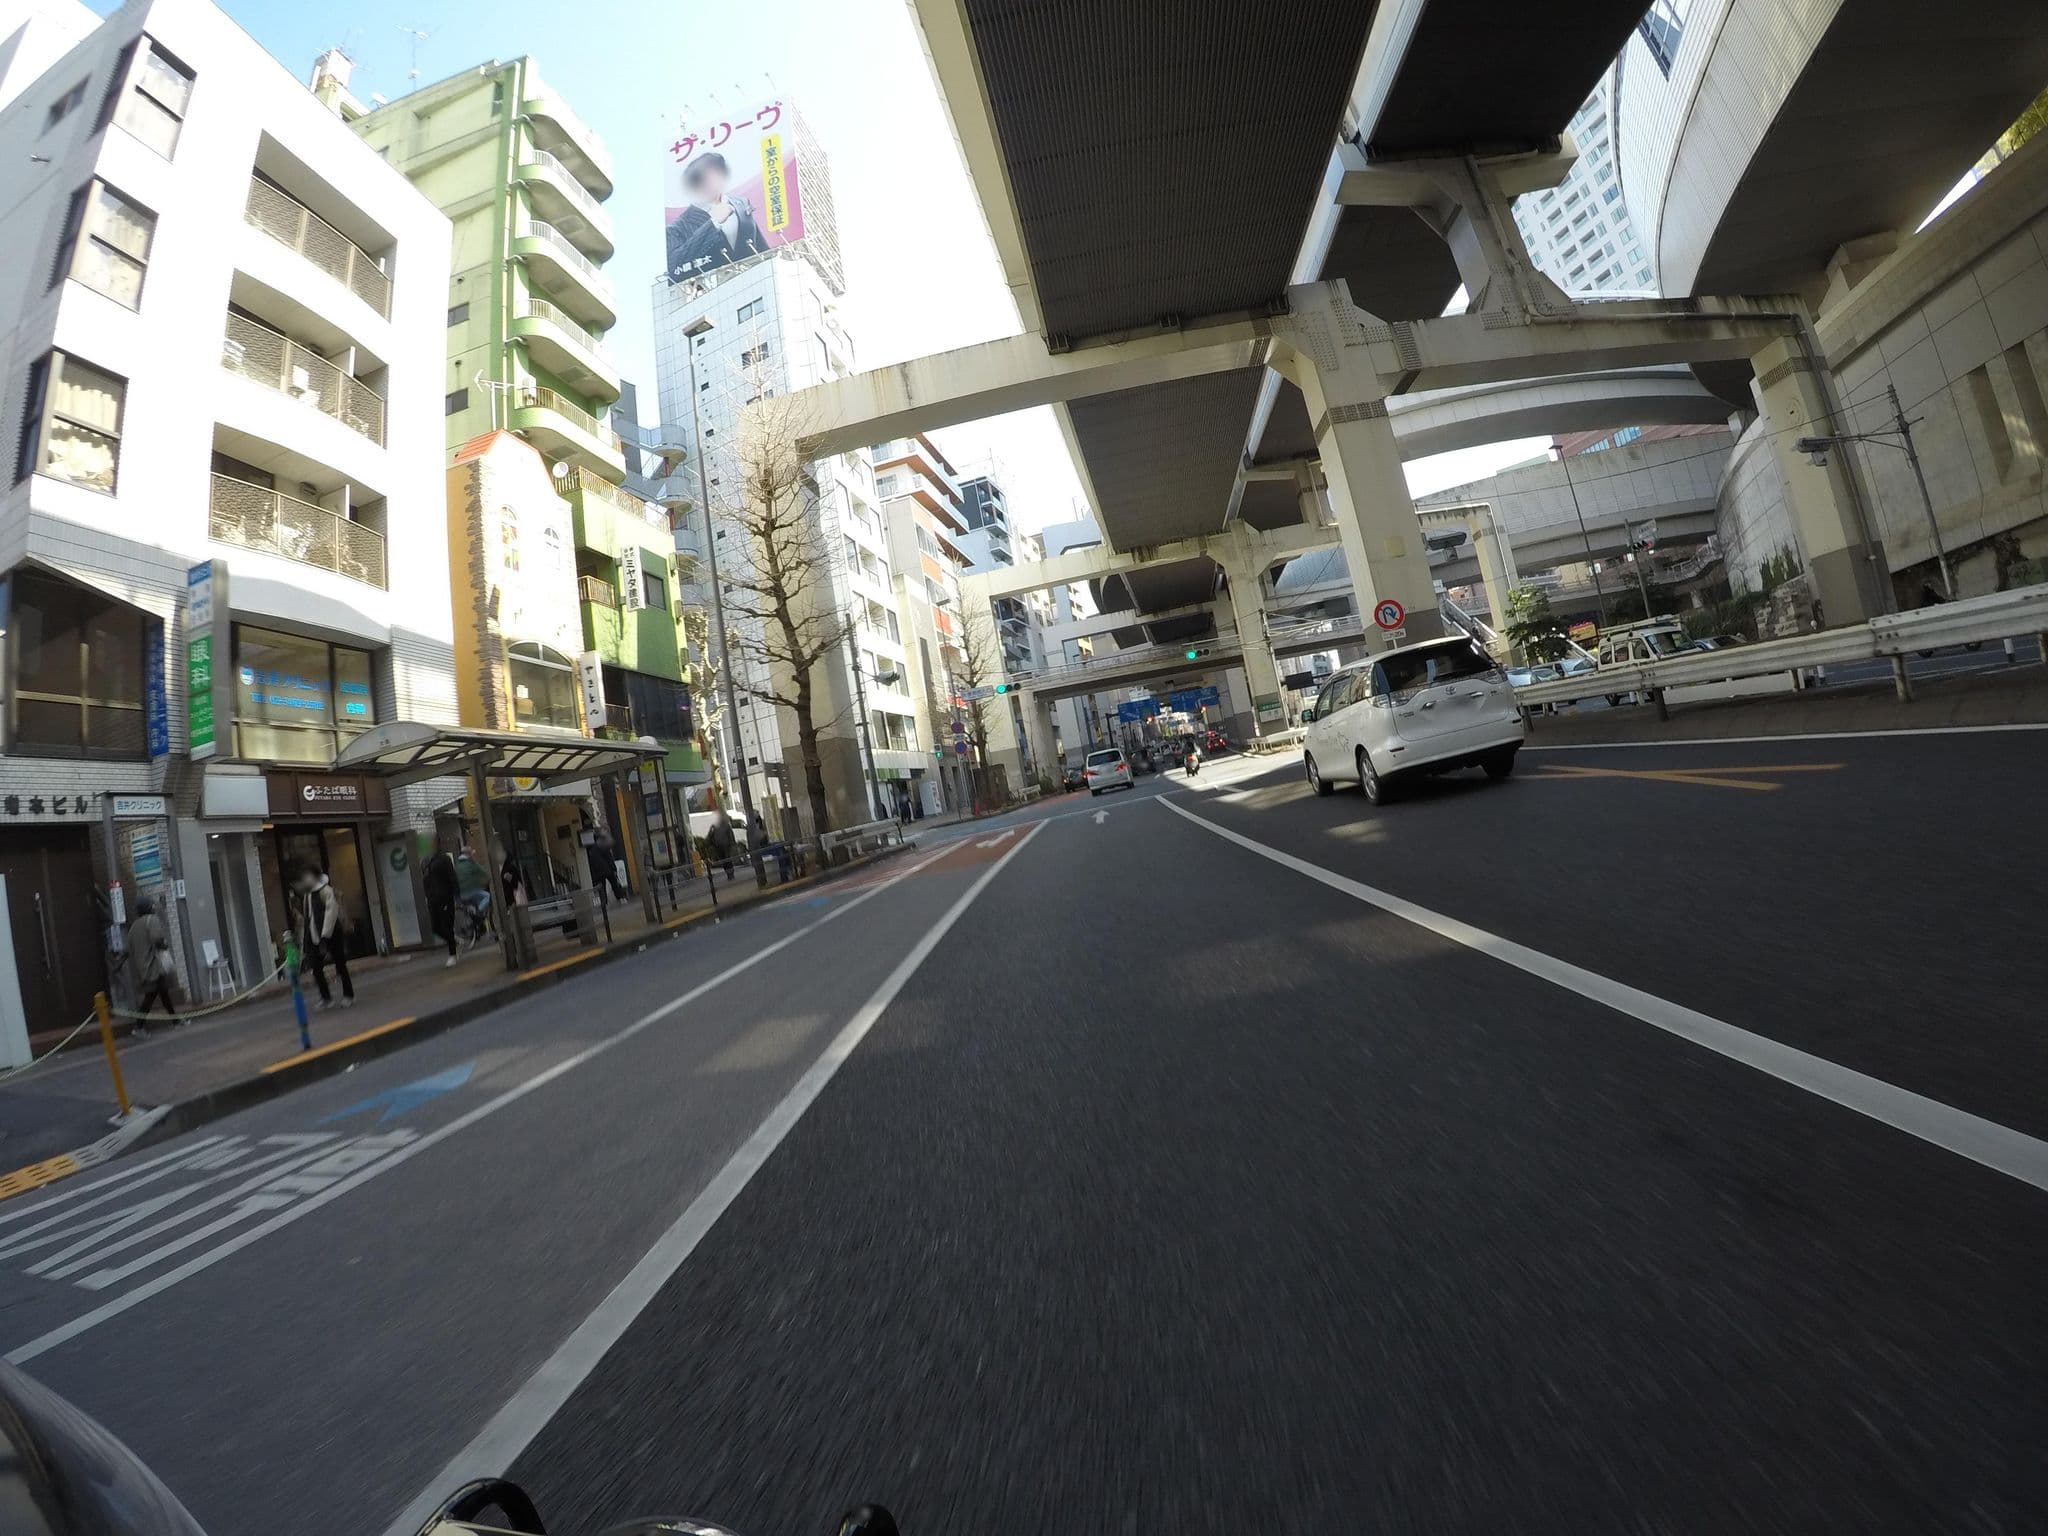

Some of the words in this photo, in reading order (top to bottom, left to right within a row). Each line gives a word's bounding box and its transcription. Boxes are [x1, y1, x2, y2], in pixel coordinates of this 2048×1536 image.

[670, 101, 783, 163] ザ・リーヴ
[191, 641, 211, 688] 眼科
[314, 785, 358, 796] ふたば眼科
